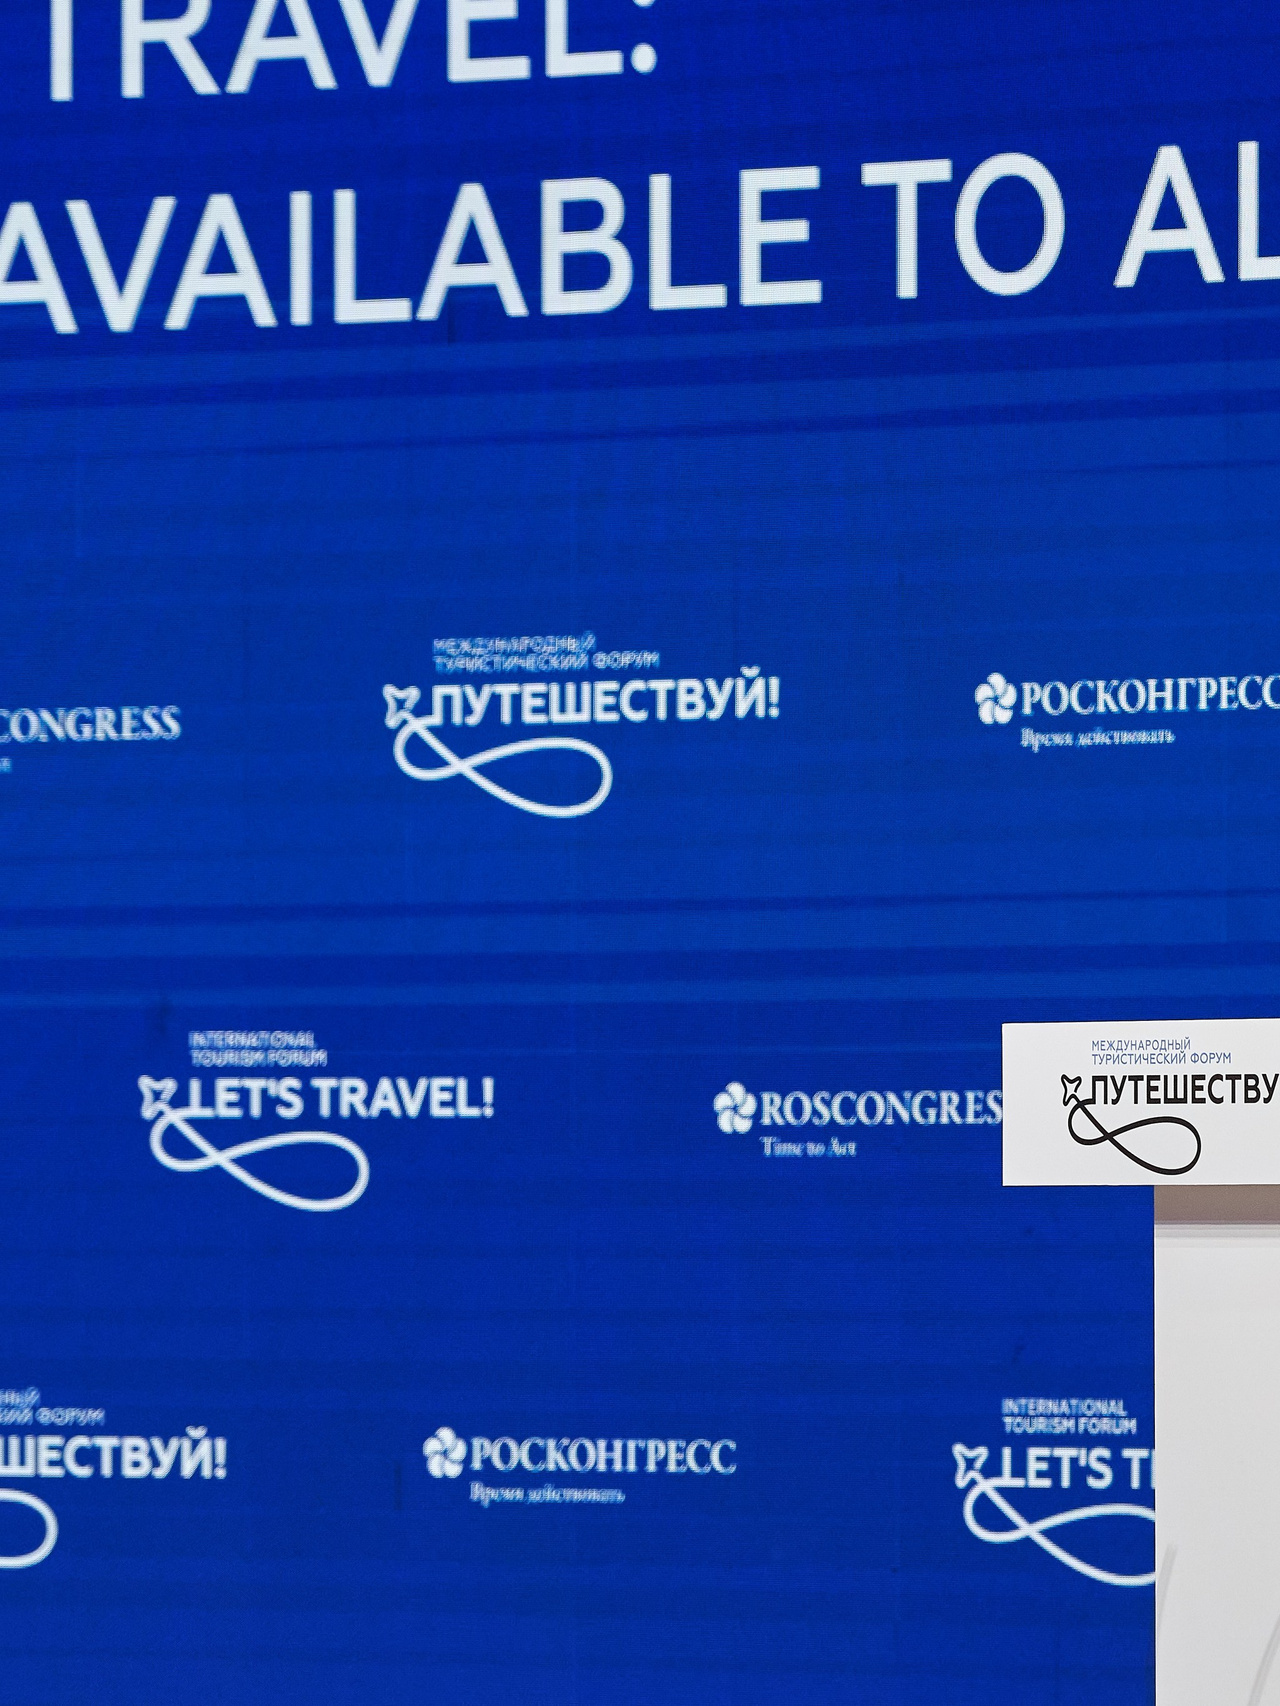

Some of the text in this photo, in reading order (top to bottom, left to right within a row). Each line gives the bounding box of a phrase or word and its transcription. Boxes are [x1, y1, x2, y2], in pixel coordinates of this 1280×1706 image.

[0, 165, 823, 334] AVAILABLE
[861, 152, 1065, 300] TO
[431, 664, 780, 727] ПУТЕШЕСТВУЙ!
[1091, 1036, 1191, 1053] МЕЖДУНАРОДНЫЙ
[1091, 1050, 1232, 1065] ТУРИСТИЧЕСКИЙ ФОРУМ
[187, 1075, 495, 1120] LET'S TRAVEL!
[1002, 1397, 1127, 1417] INTERNATIONAL
[1003, 1416, 1138, 1435] TOURISM FORUM
[469, 1436, 737, 1474] РОСКОНГРЕСС
[1002, 1446, 1114, 1490] LET'S
